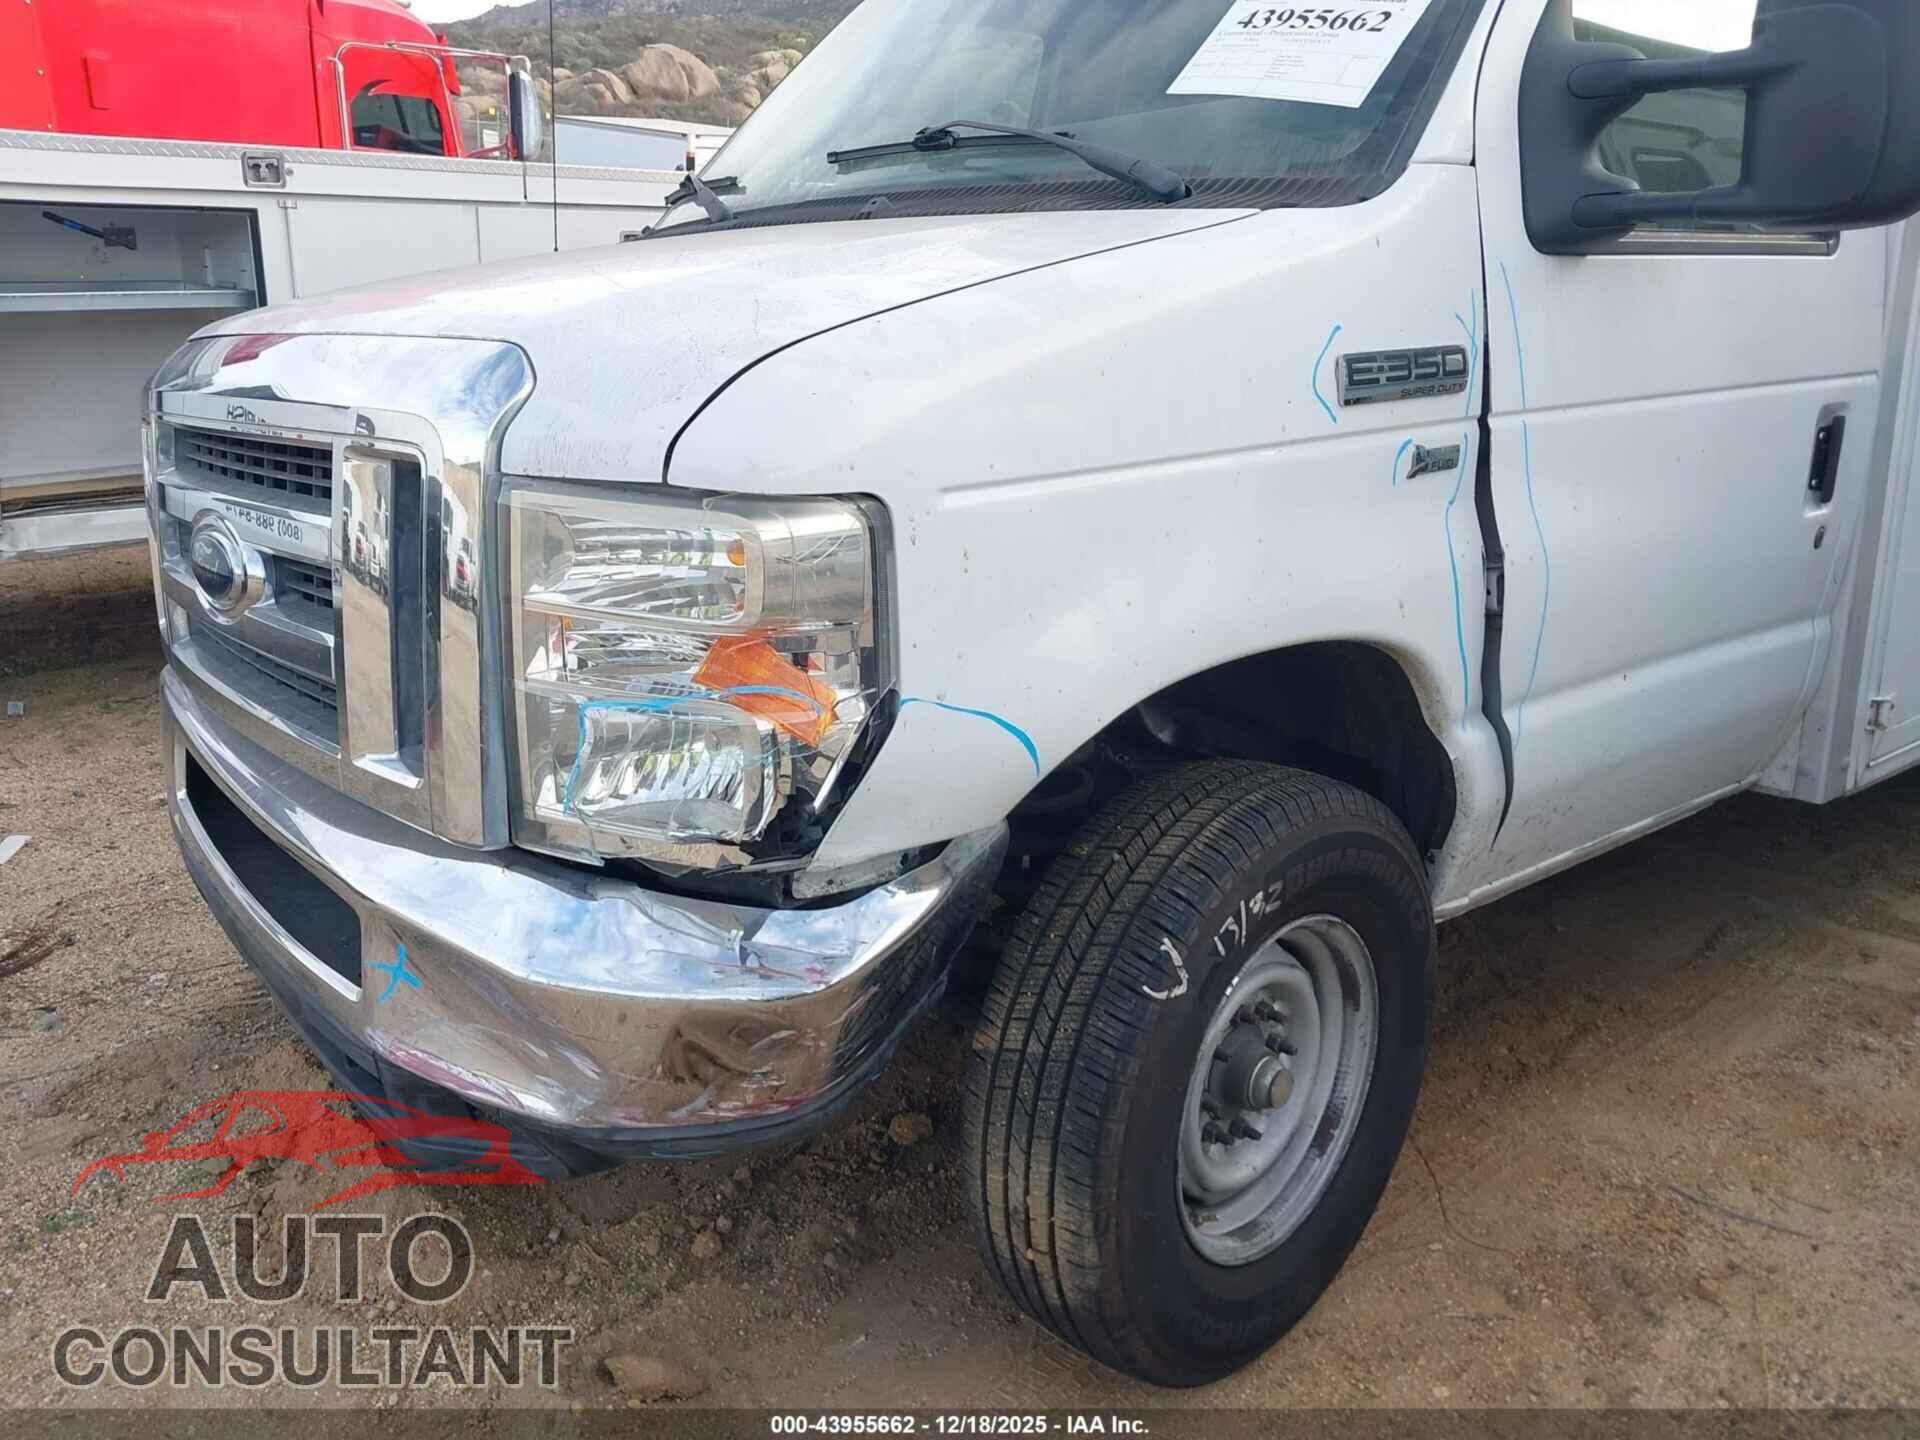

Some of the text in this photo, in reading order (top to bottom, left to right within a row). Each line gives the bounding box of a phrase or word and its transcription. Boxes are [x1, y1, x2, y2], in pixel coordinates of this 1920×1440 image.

[1237, 7, 1393, 33] 43955662
[1400, 382, 1466, 398] SUPER DUTY
